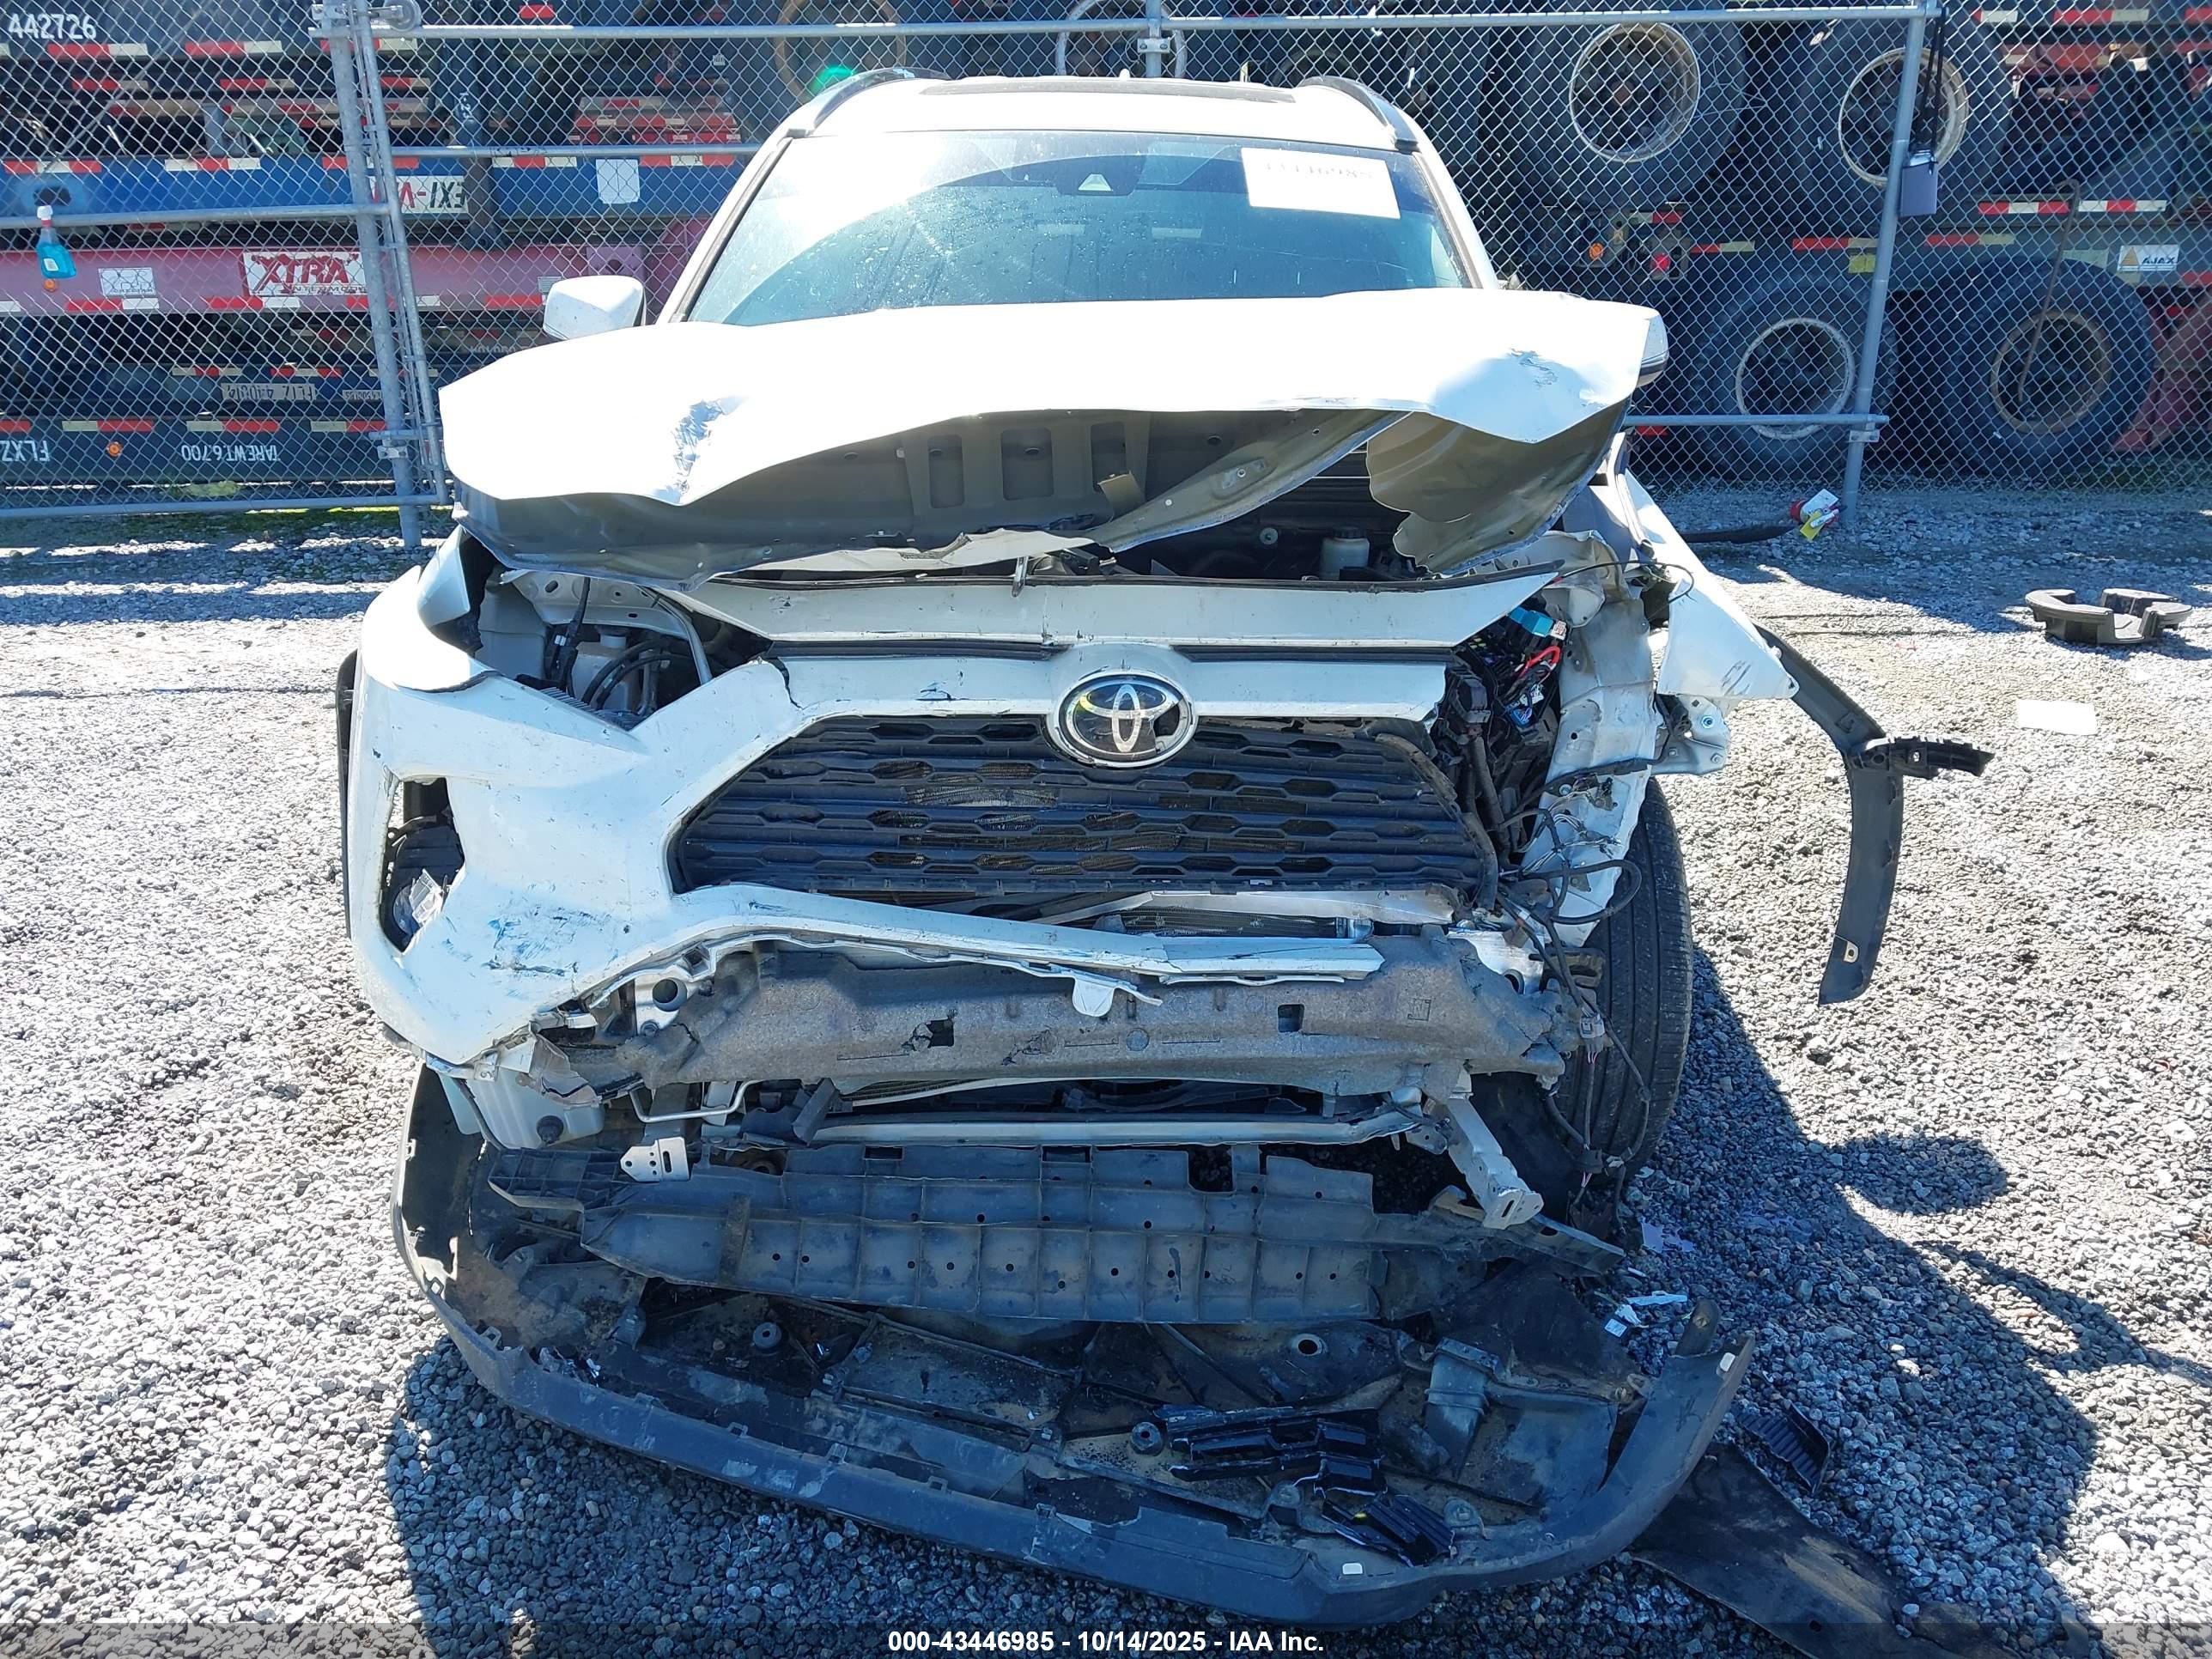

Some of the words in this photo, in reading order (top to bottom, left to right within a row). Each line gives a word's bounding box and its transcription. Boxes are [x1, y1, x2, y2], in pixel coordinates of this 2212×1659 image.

[8, 13, 97, 40] 442726
[2142, 255, 2175, 264] AJAX
[253, 257, 350, 291] XTRA
